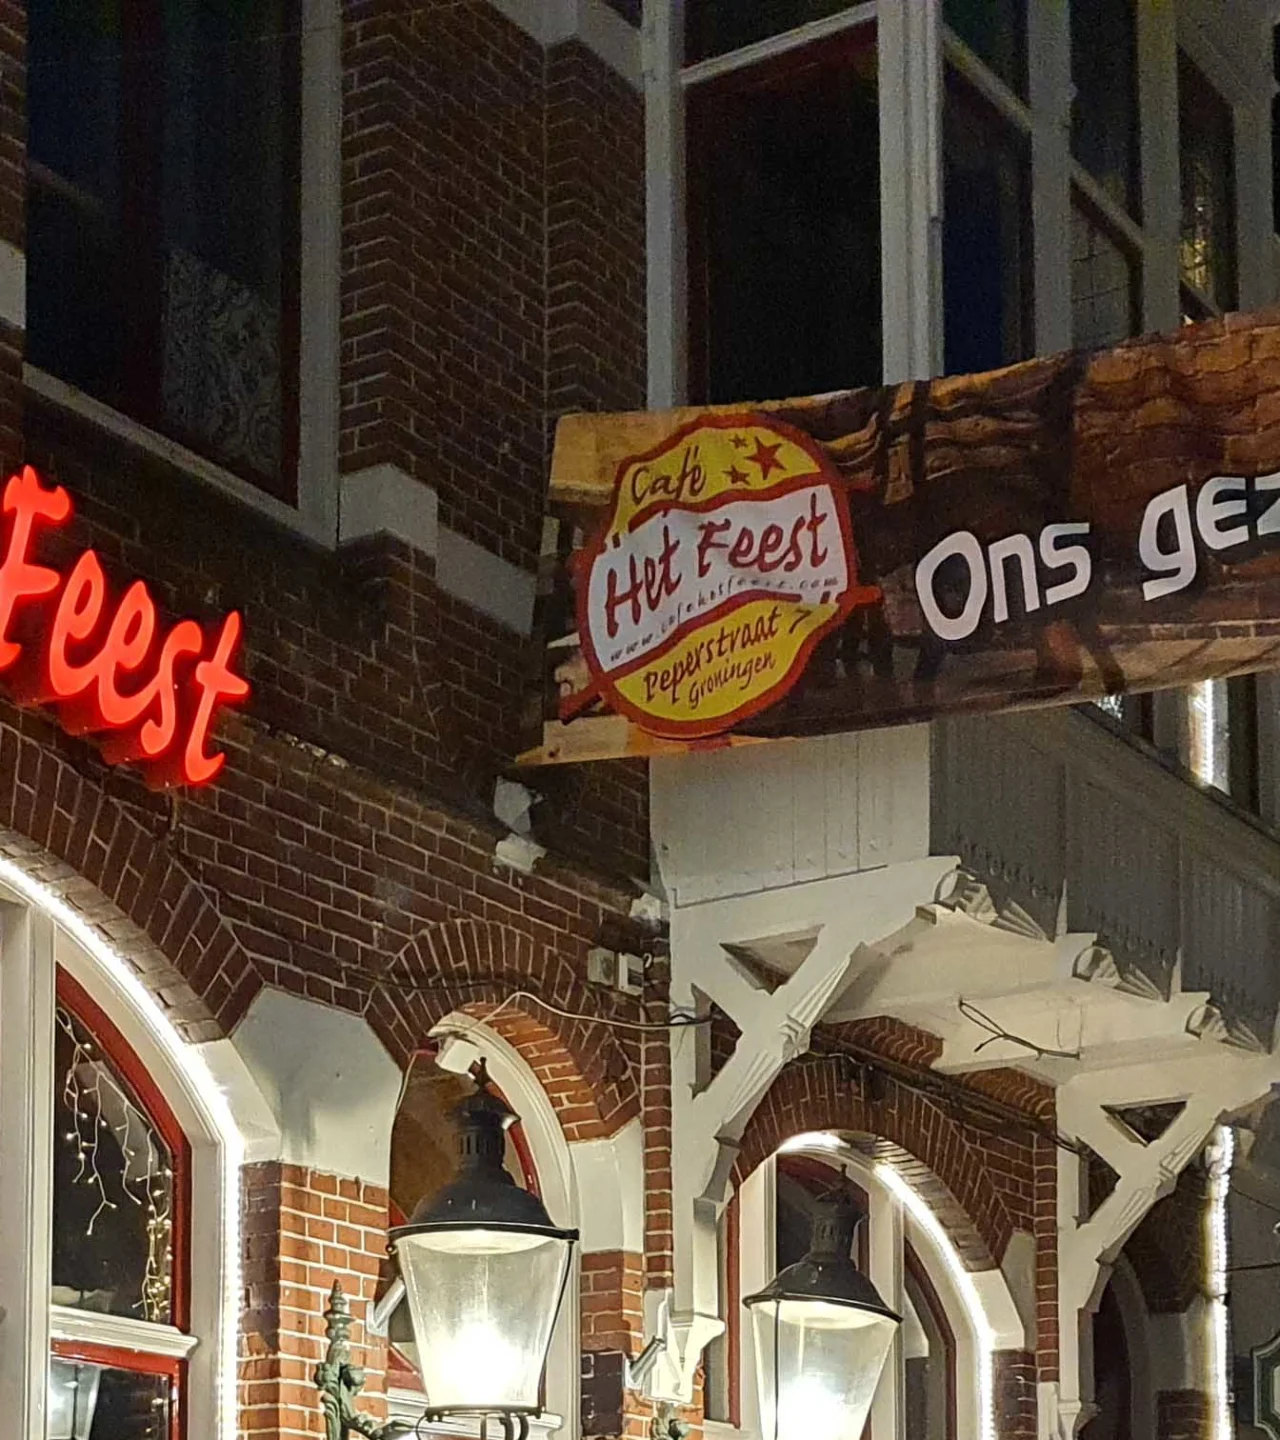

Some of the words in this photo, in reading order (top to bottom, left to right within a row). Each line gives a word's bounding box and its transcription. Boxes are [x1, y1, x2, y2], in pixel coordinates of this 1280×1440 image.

[630, 446, 708, 505] Café
[603, 523, 683, 639] Het
[695, 492, 829, 579] Feest
[915, 522, 1092, 641] Ons
[642, 608, 783, 706] Peperstraat
[788, 608, 813, 635] 7
